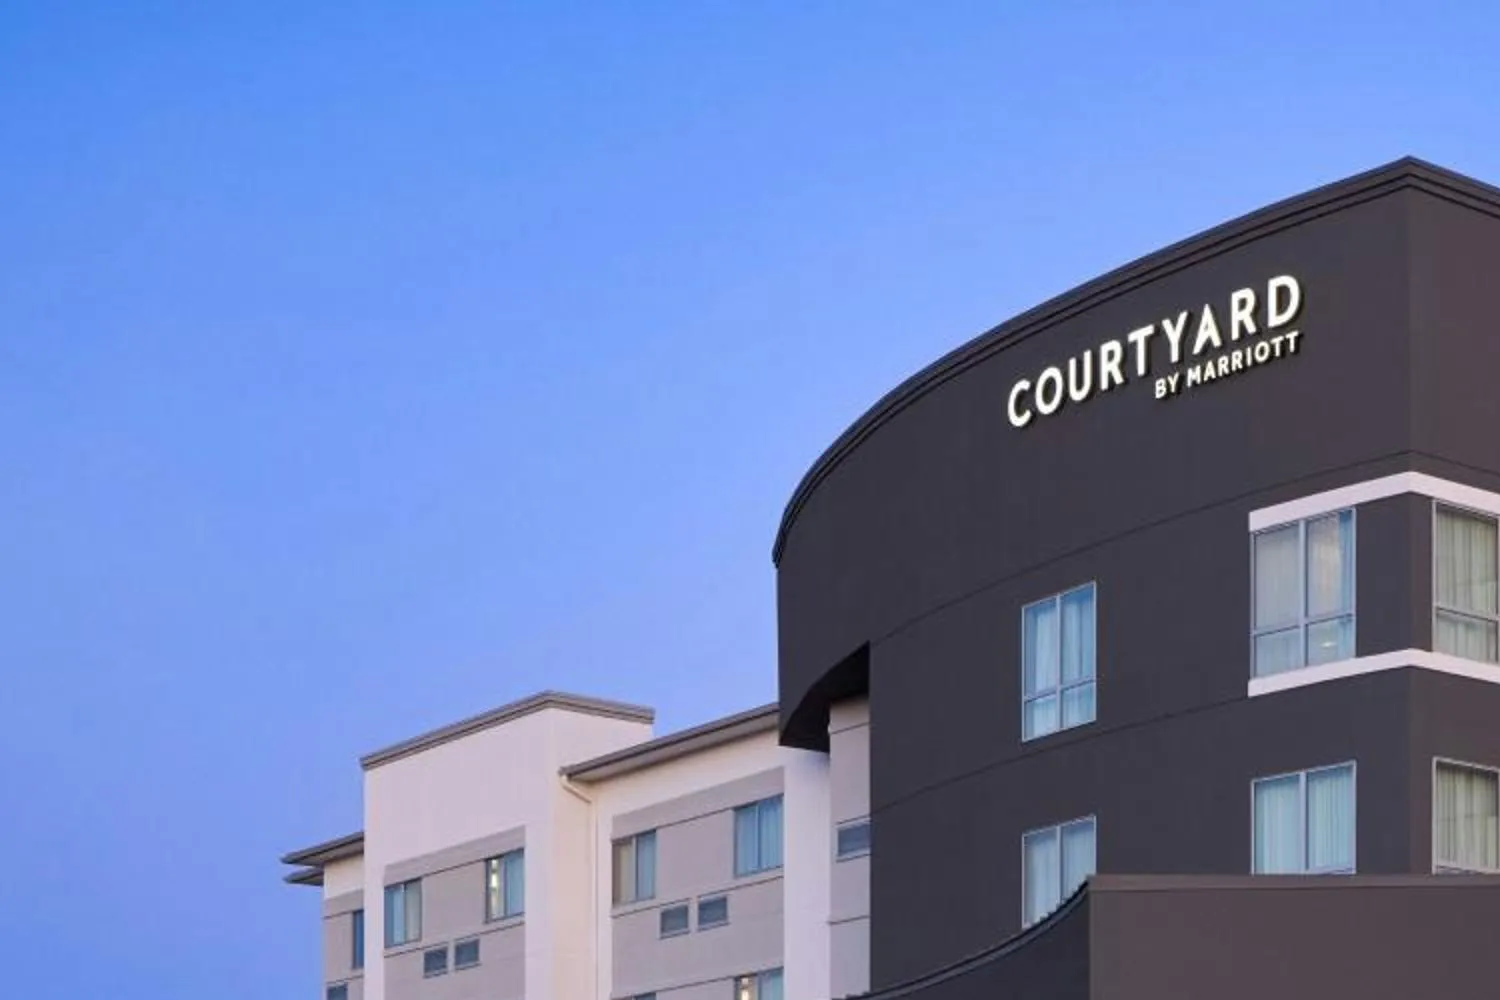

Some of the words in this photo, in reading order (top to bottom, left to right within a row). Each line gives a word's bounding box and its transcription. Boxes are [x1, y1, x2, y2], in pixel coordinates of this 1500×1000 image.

[1006, 274, 1302, 428] COURTYARD
[1154, 372, 1180, 400] BY
[1186, 330, 1300, 388] MARRIOTT
